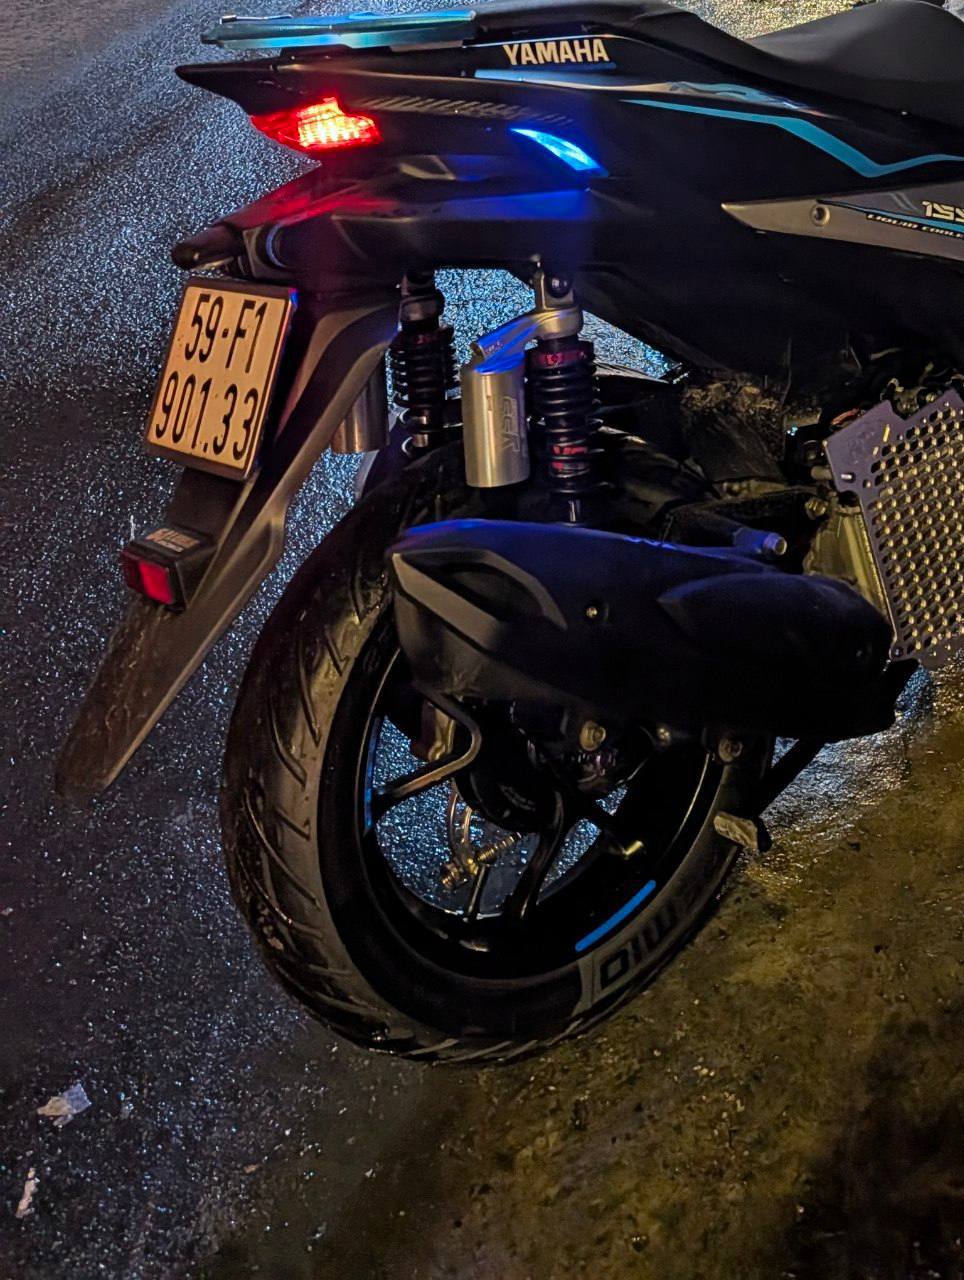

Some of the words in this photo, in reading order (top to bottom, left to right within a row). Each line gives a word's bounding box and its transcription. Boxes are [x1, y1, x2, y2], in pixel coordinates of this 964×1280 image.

[502, 39, 610, 66] YAMAHA
[185, 293, 268, 374] 59-F1
[155, 370, 259, 461] 901.33
